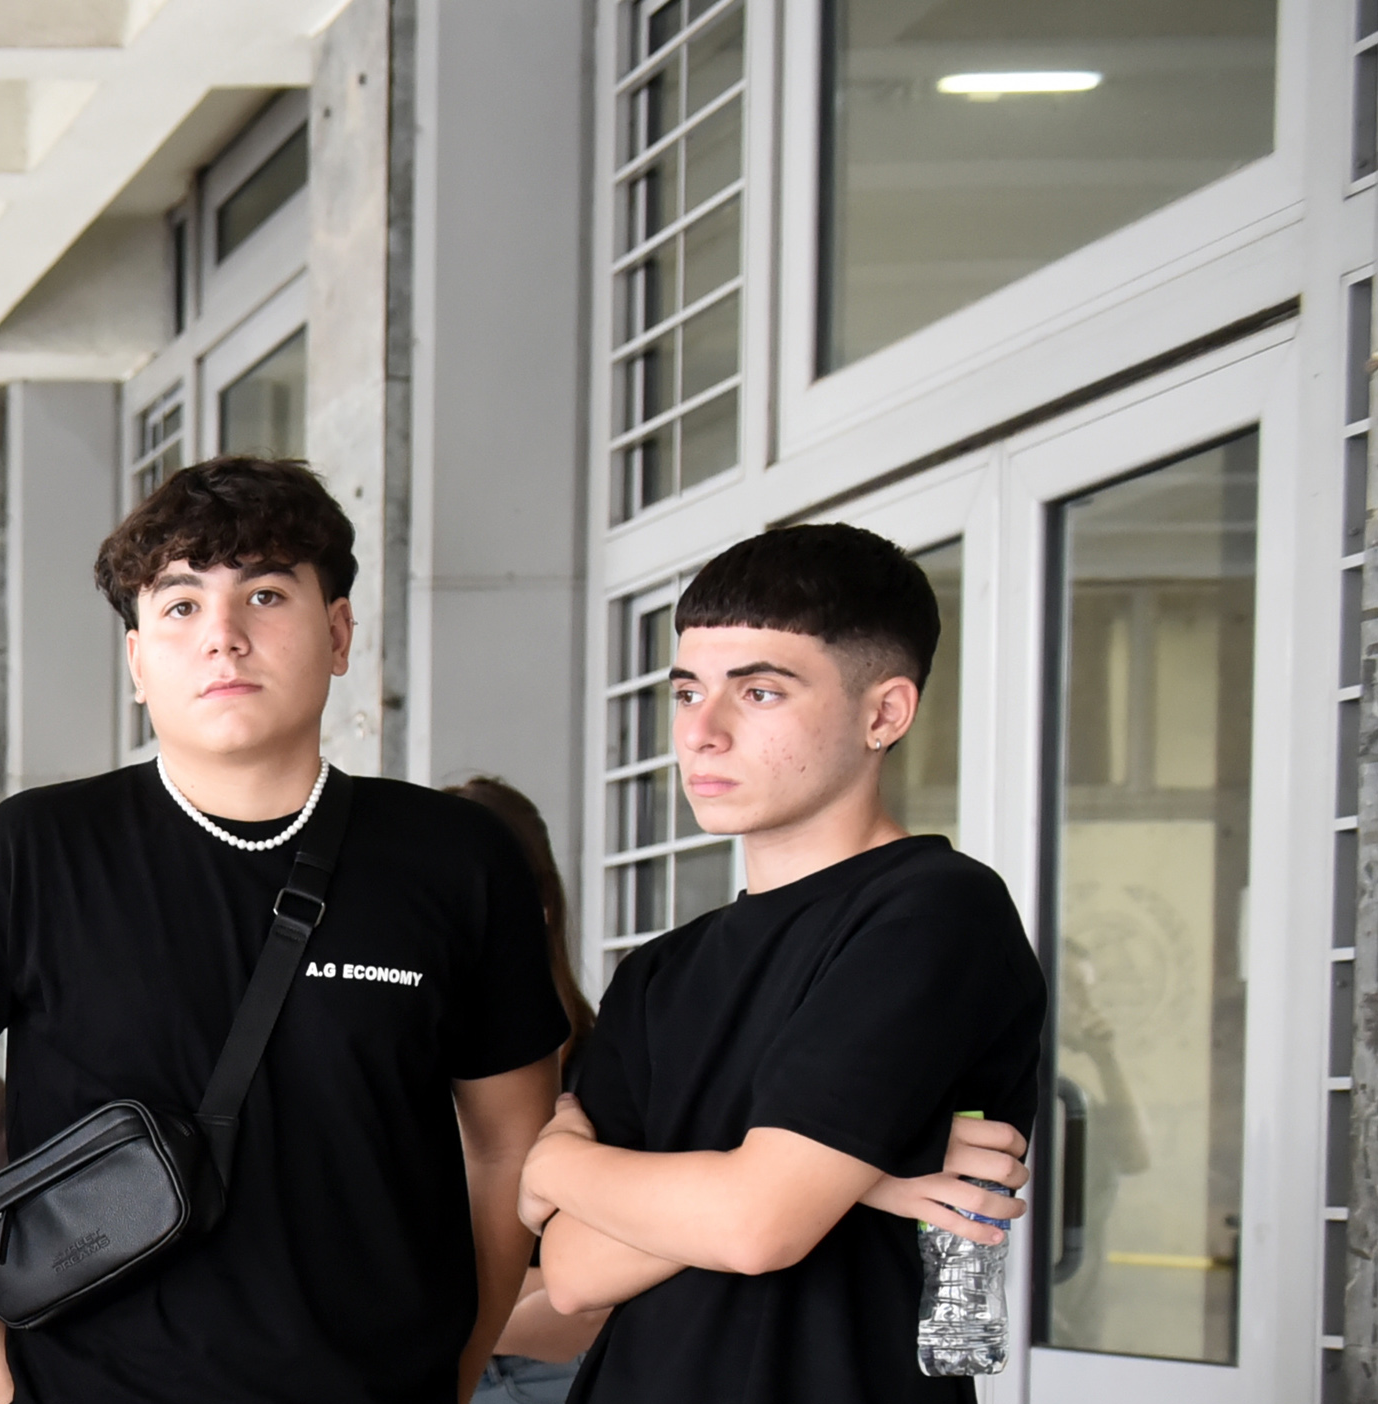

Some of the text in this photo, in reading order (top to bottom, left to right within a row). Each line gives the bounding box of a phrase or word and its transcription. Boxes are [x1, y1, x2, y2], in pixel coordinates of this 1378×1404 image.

[306, 961, 423, 987] A.G ECONOMY
[52, 1234, 111, 1274] DREAMS
